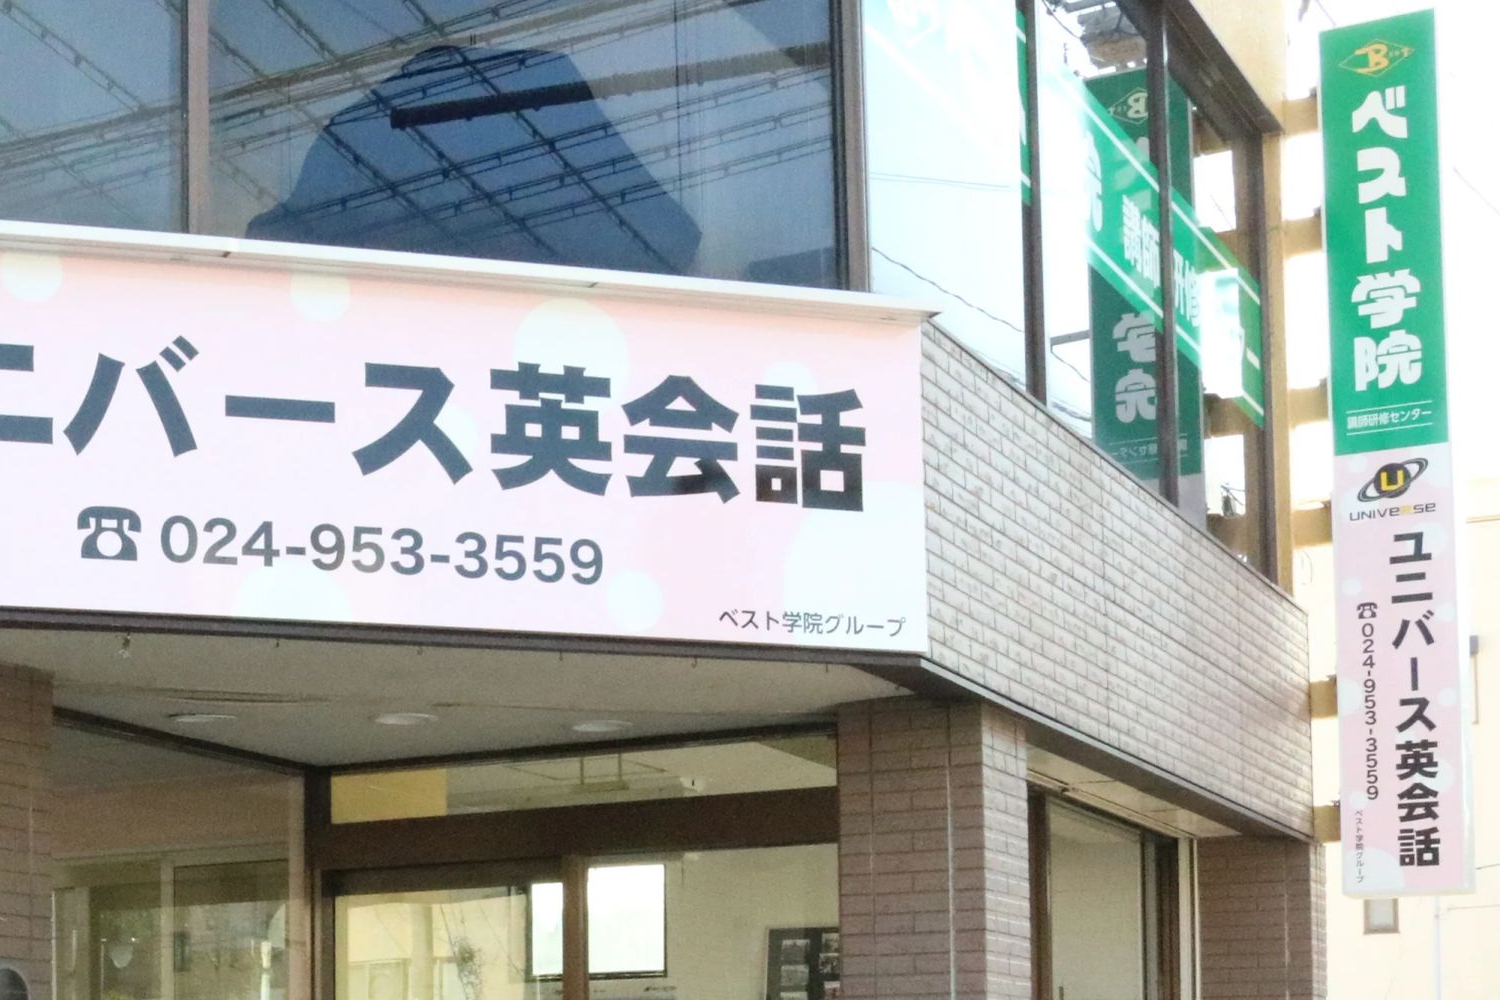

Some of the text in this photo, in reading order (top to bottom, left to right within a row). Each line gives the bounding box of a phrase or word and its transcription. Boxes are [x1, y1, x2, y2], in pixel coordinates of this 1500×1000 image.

[1351, 85, 1422, 392] ベスト学院
[160, 513, 604, 587] 024-953-3559
[718, 608, 907, 638] ベスト学院グループ
[1361, 622, 1379, 801] 024-953-3559
[1389, 530, 1441, 868] ユニバース英会話
